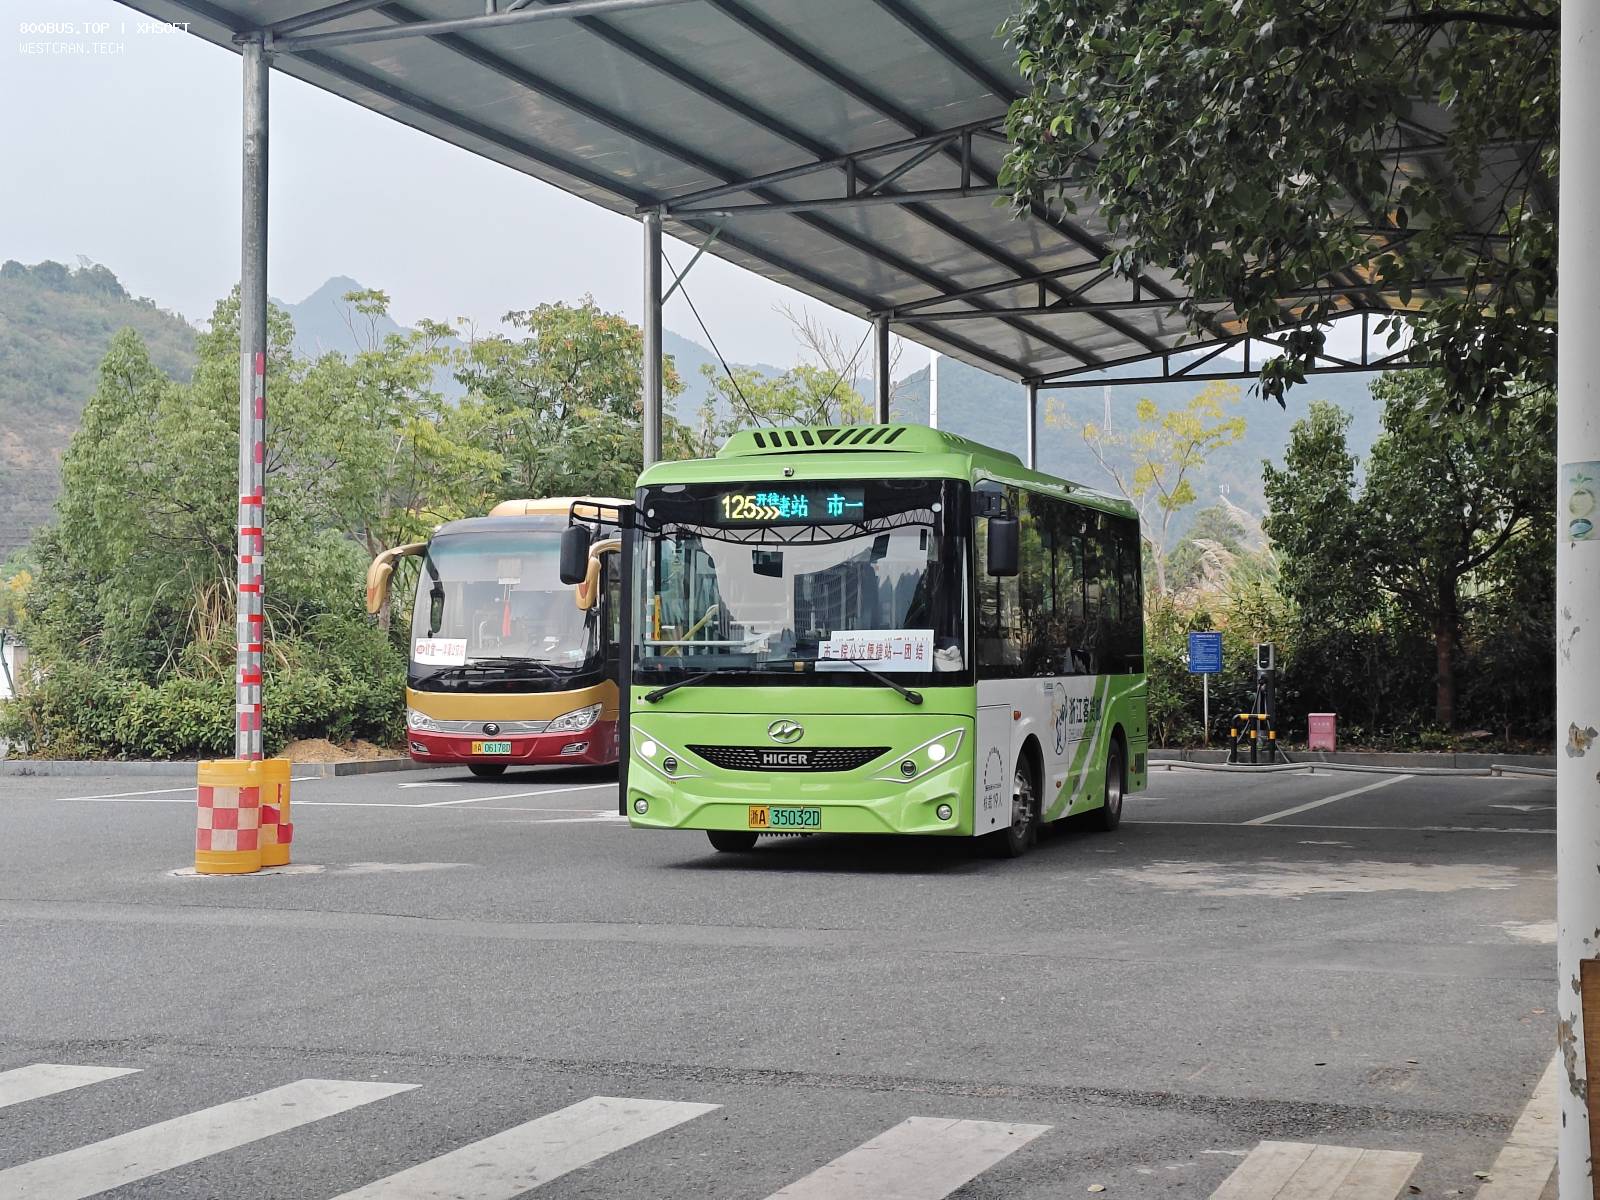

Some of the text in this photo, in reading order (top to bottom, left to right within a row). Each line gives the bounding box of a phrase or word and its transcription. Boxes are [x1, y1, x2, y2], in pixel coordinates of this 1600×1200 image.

[721, 494, 757, 519] 125
[756, 492, 780, 506] 开往
[763, 753, 808, 765] HIGER
[772, 809, 820, 826] 35032D
